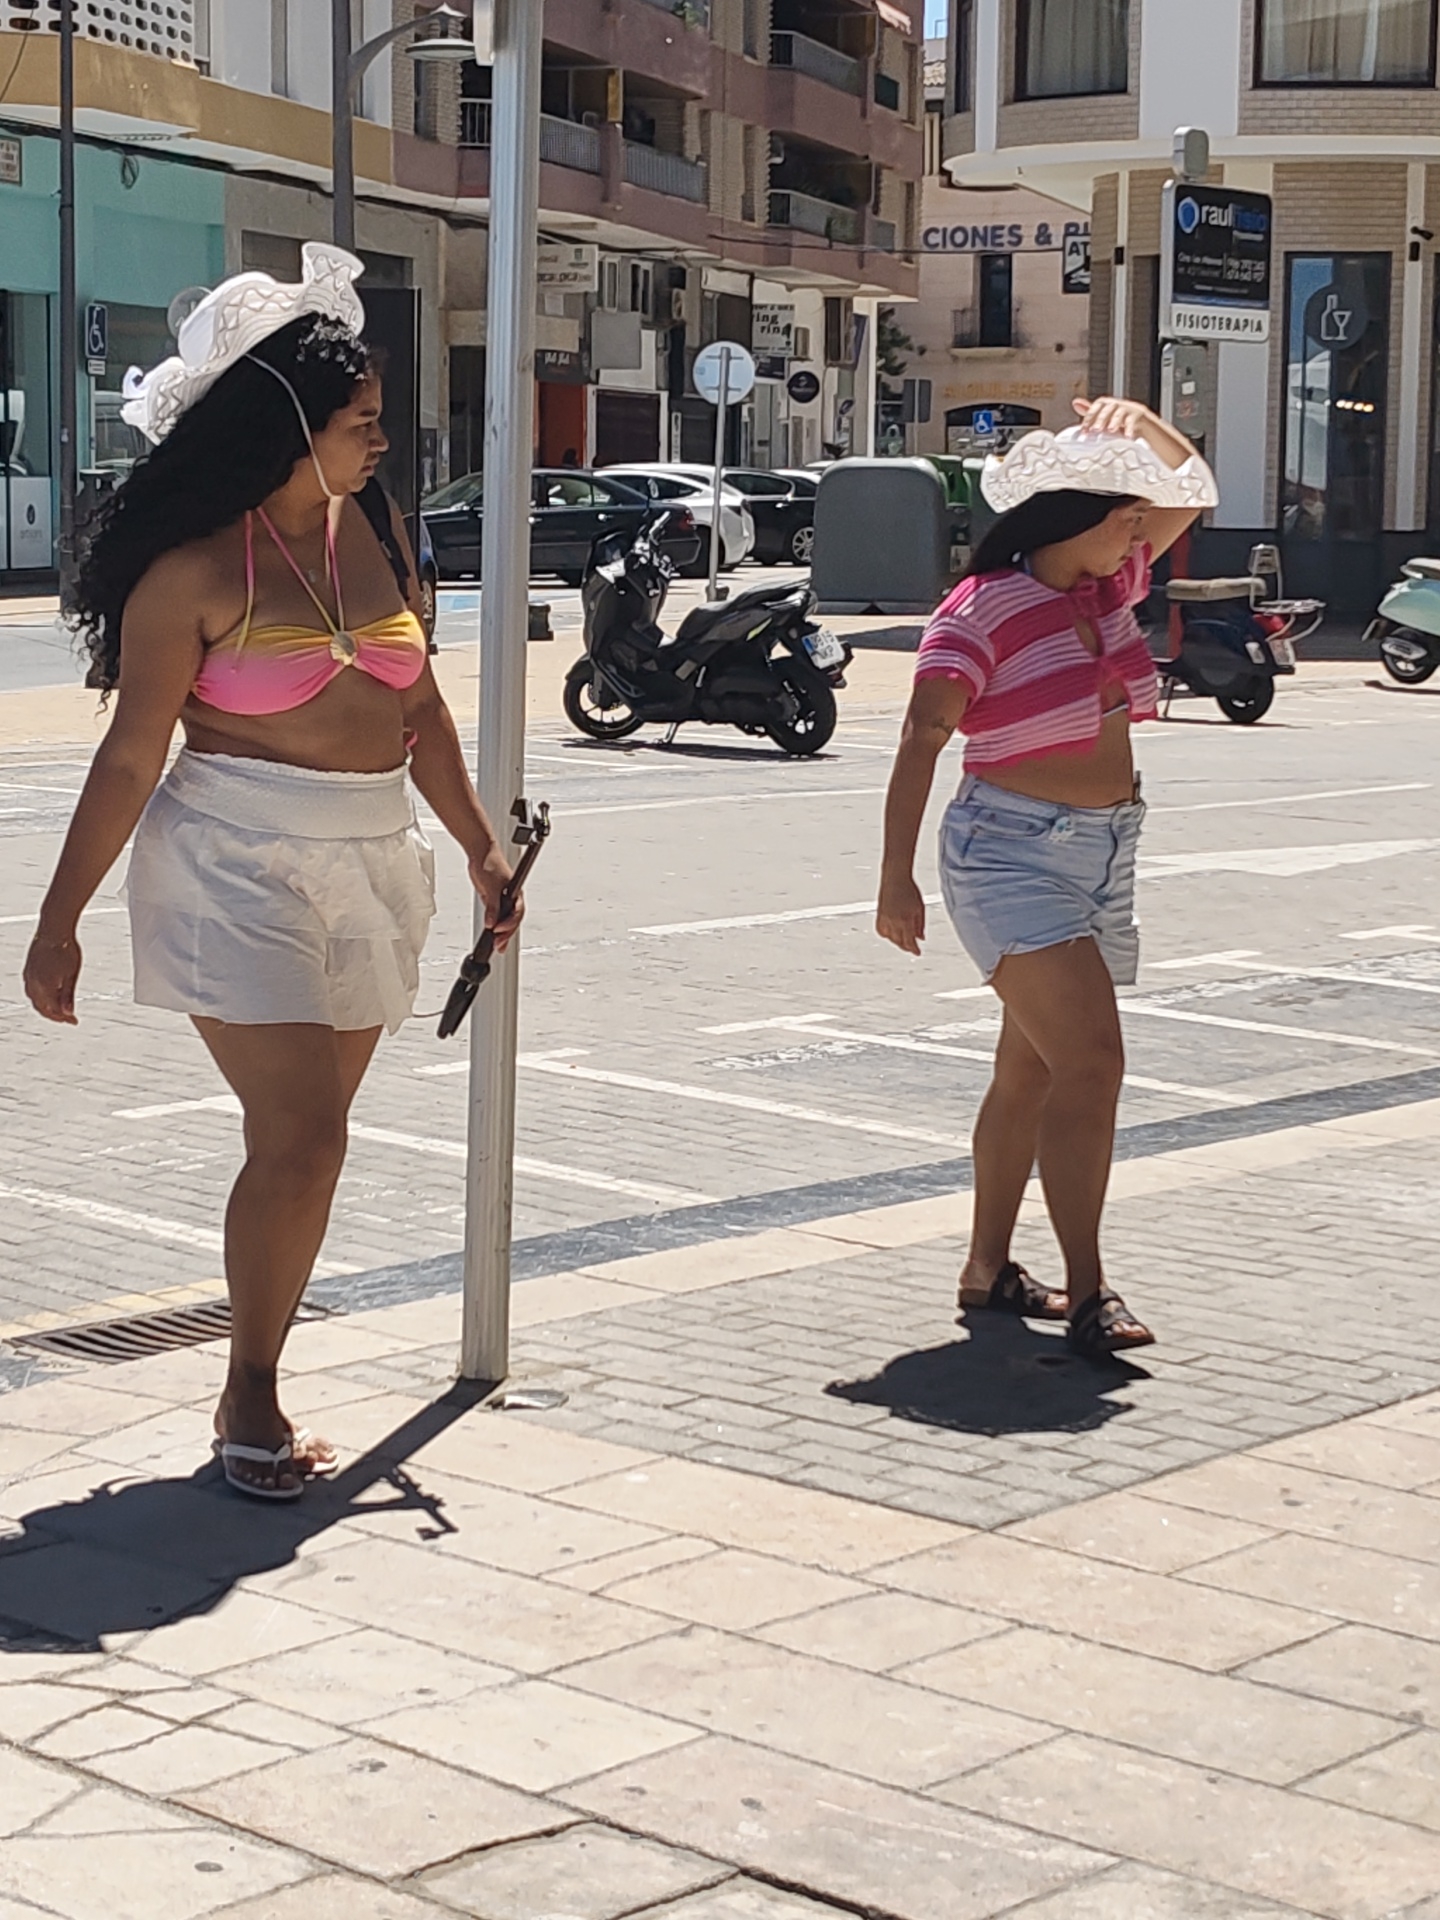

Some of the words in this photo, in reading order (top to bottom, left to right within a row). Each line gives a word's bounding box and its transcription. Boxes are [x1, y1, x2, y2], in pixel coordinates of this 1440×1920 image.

[922, 224, 1023, 249] CIONES
[1034, 222, 1053, 246] &
[1176, 312, 1264, 334] FISIOTERAPIA
